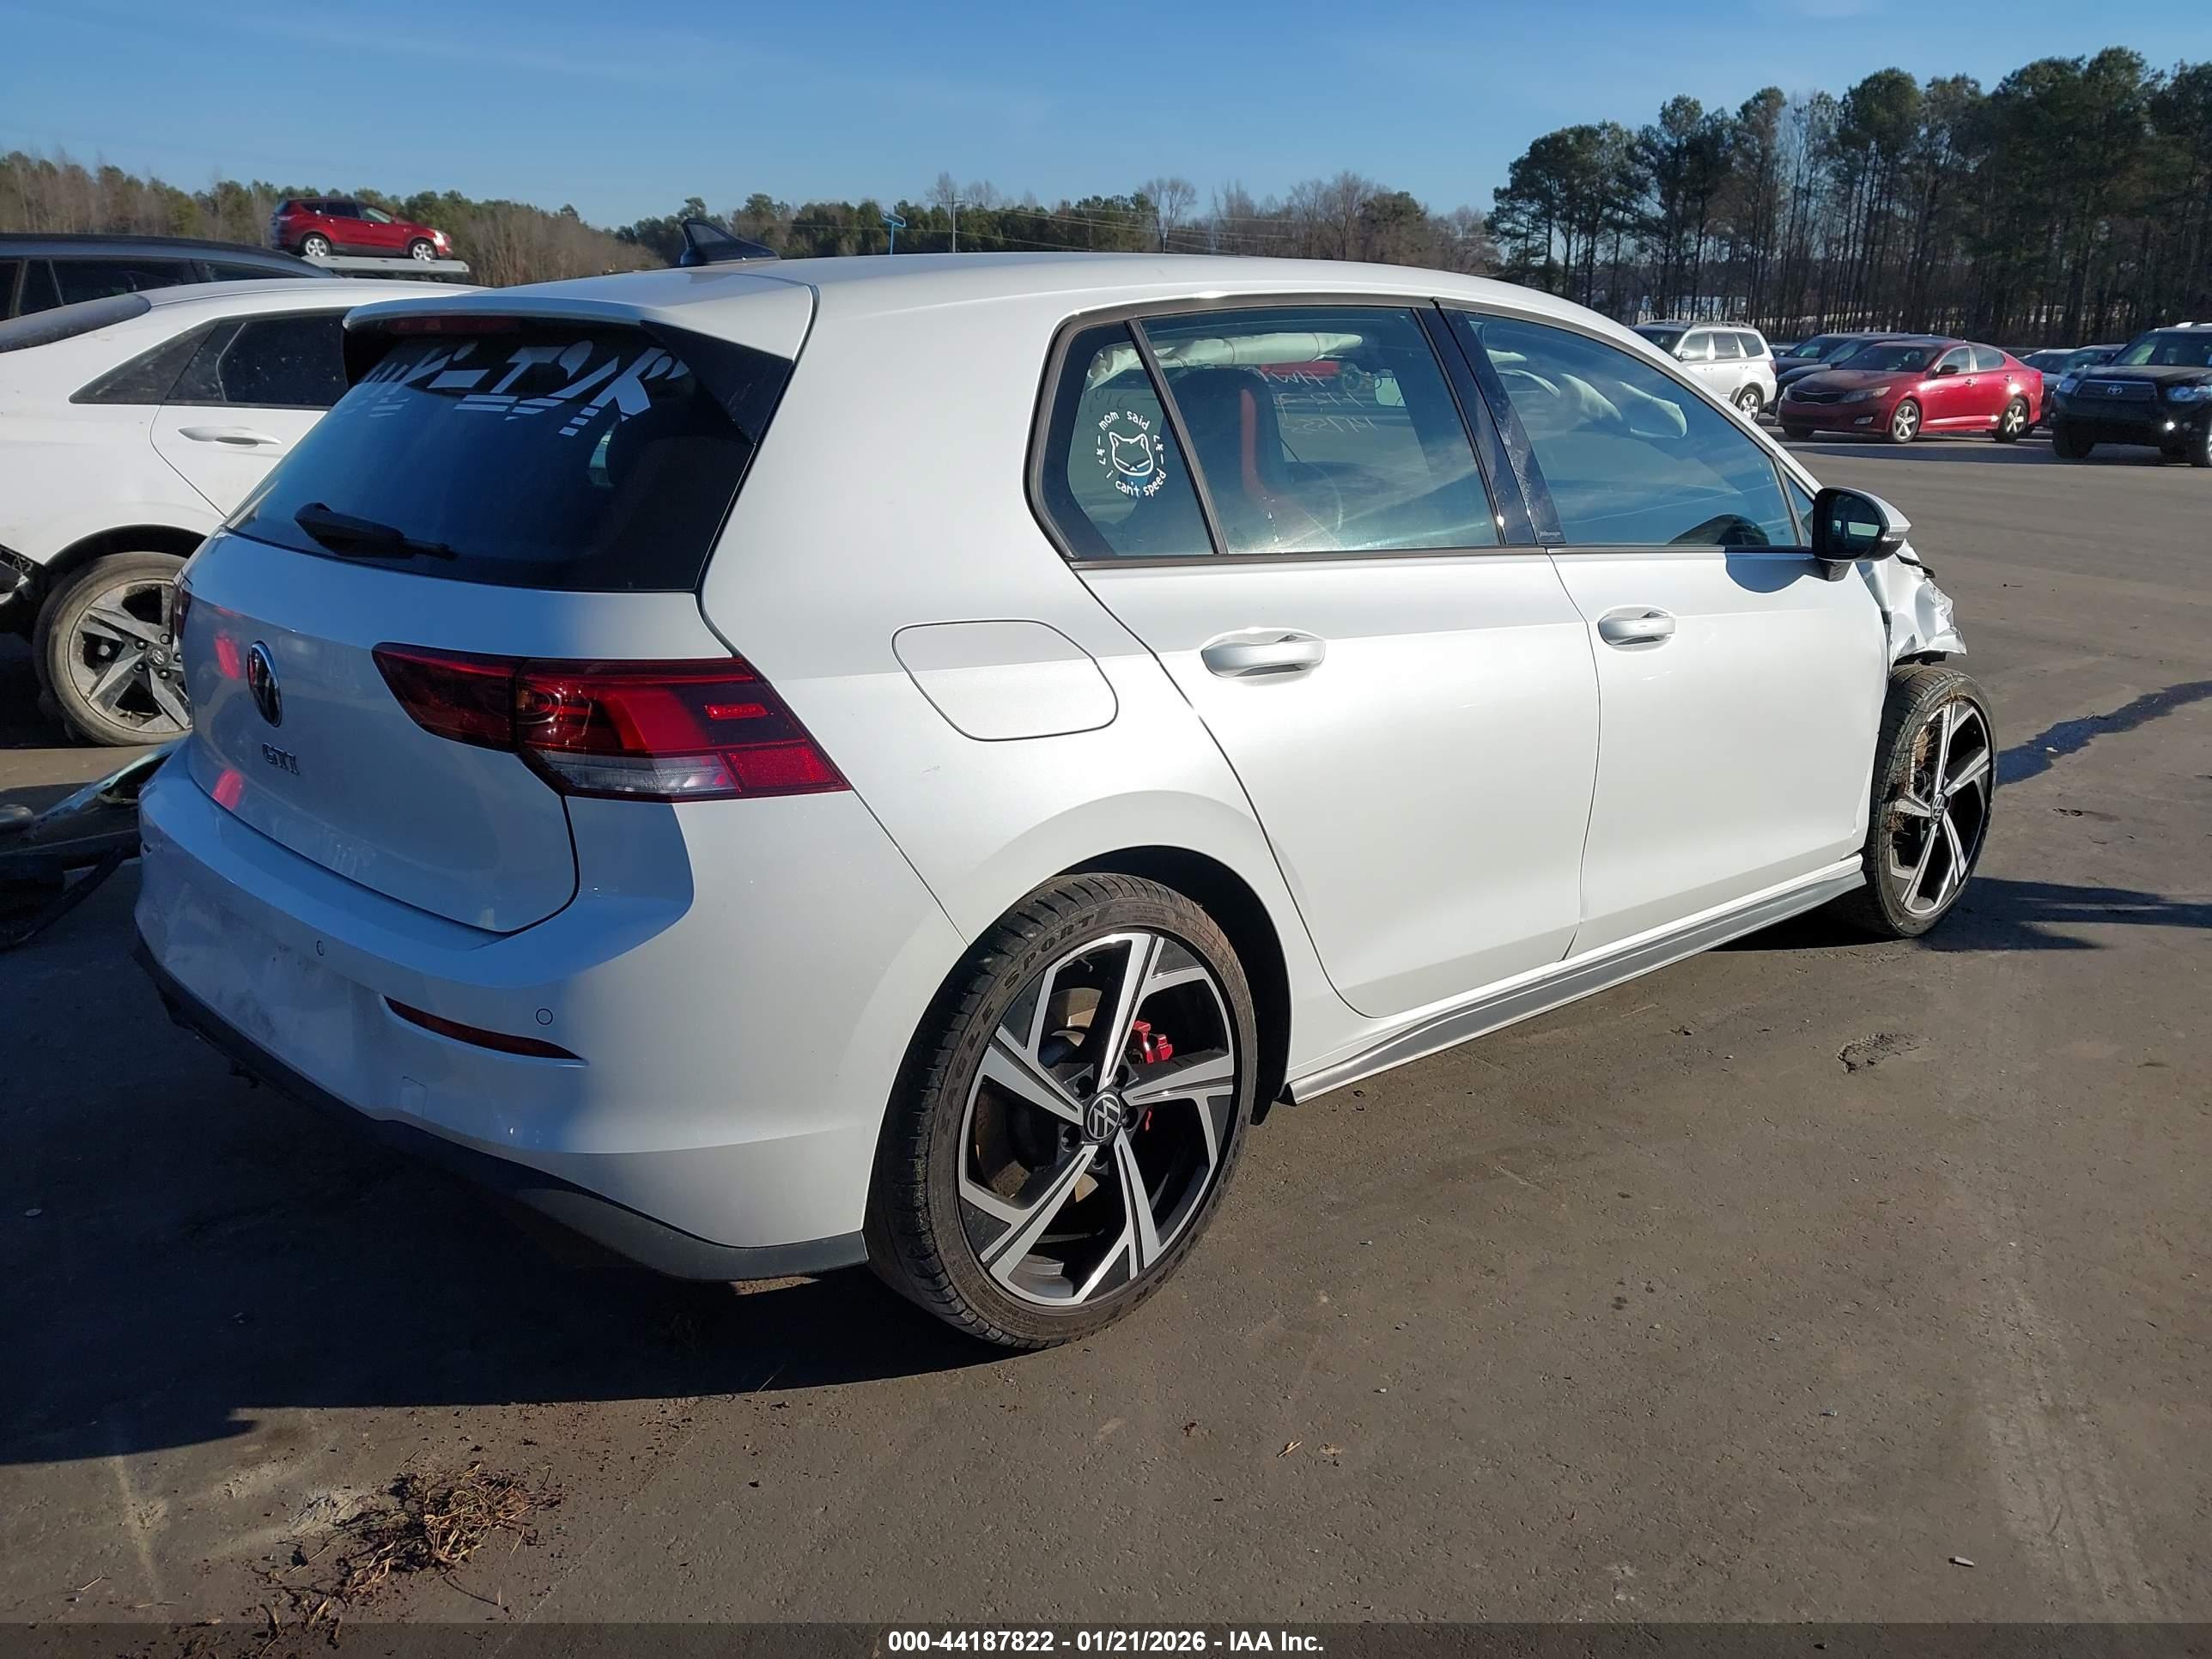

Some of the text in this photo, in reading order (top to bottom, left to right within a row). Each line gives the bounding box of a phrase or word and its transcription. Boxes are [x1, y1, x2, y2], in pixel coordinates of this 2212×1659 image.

[1098, 410, 1151, 431] mom said
[1143, 468, 1167, 497] speed
[262, 742, 301, 776] GTI
[1002, 914, 1095, 990] SPORT
